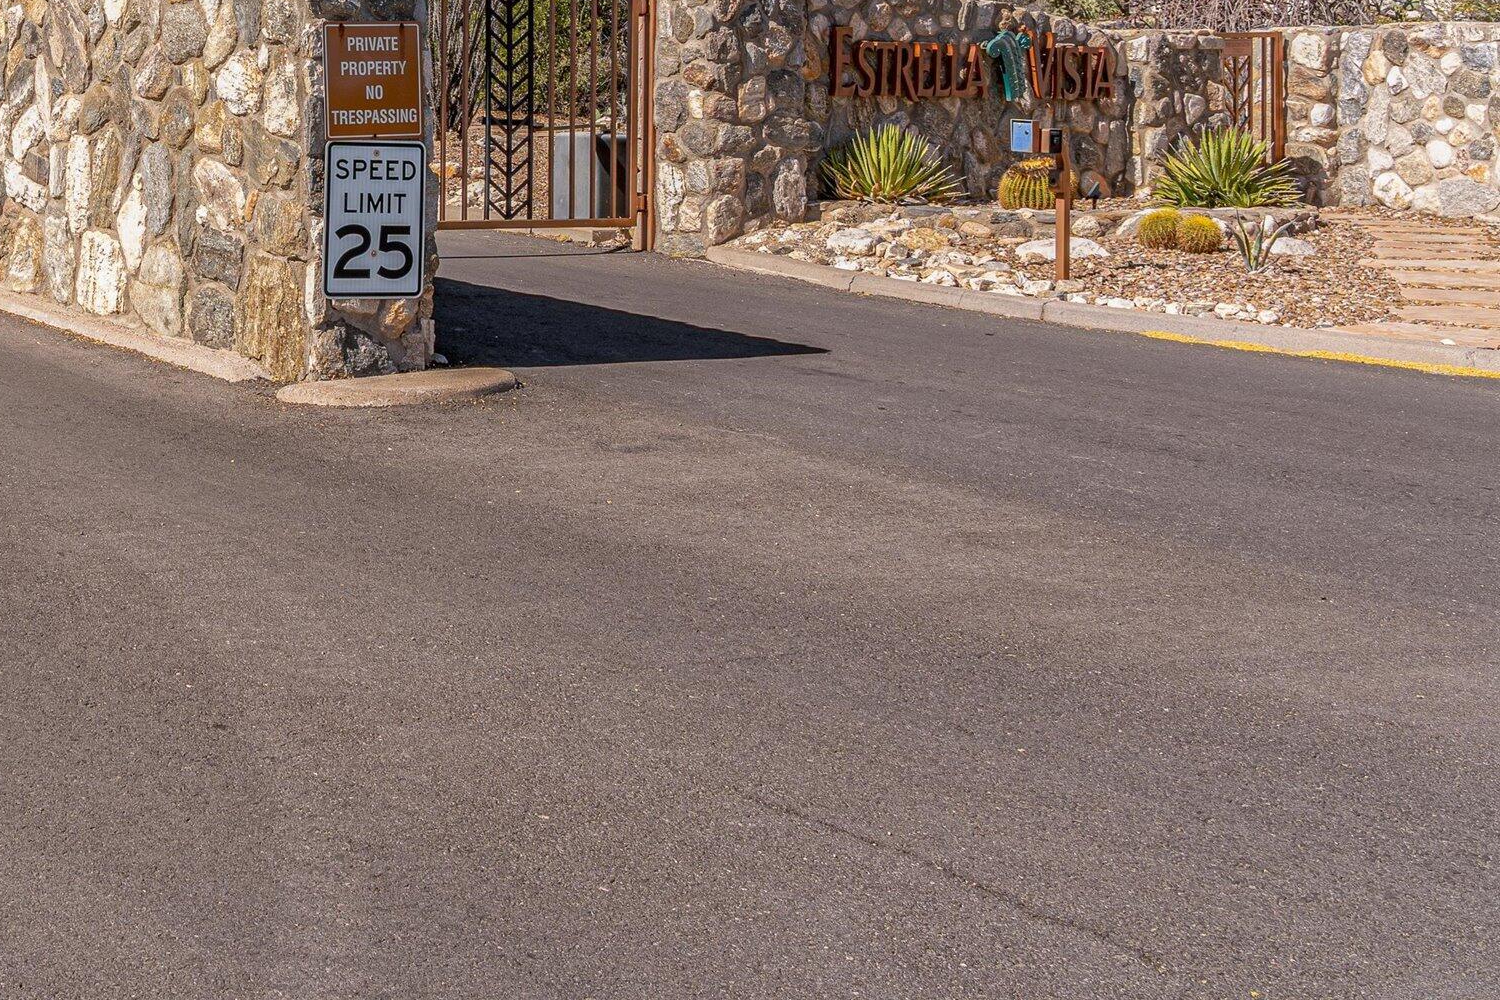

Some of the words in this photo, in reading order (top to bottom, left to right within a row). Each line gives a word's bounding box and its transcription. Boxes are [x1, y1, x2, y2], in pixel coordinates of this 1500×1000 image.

[347, 36, 399, 52] PRIVATE
[340, 60, 407, 76] PROPERTY
[1020, 25, 1116, 100] VISTA
[365, 85, 384, 100] NO
[331, 108, 418, 125] TRESPASSING
[335, 159, 417, 181] SPEED
[344, 193, 407, 214] LIMIT
[332, 224, 414, 280] 25
